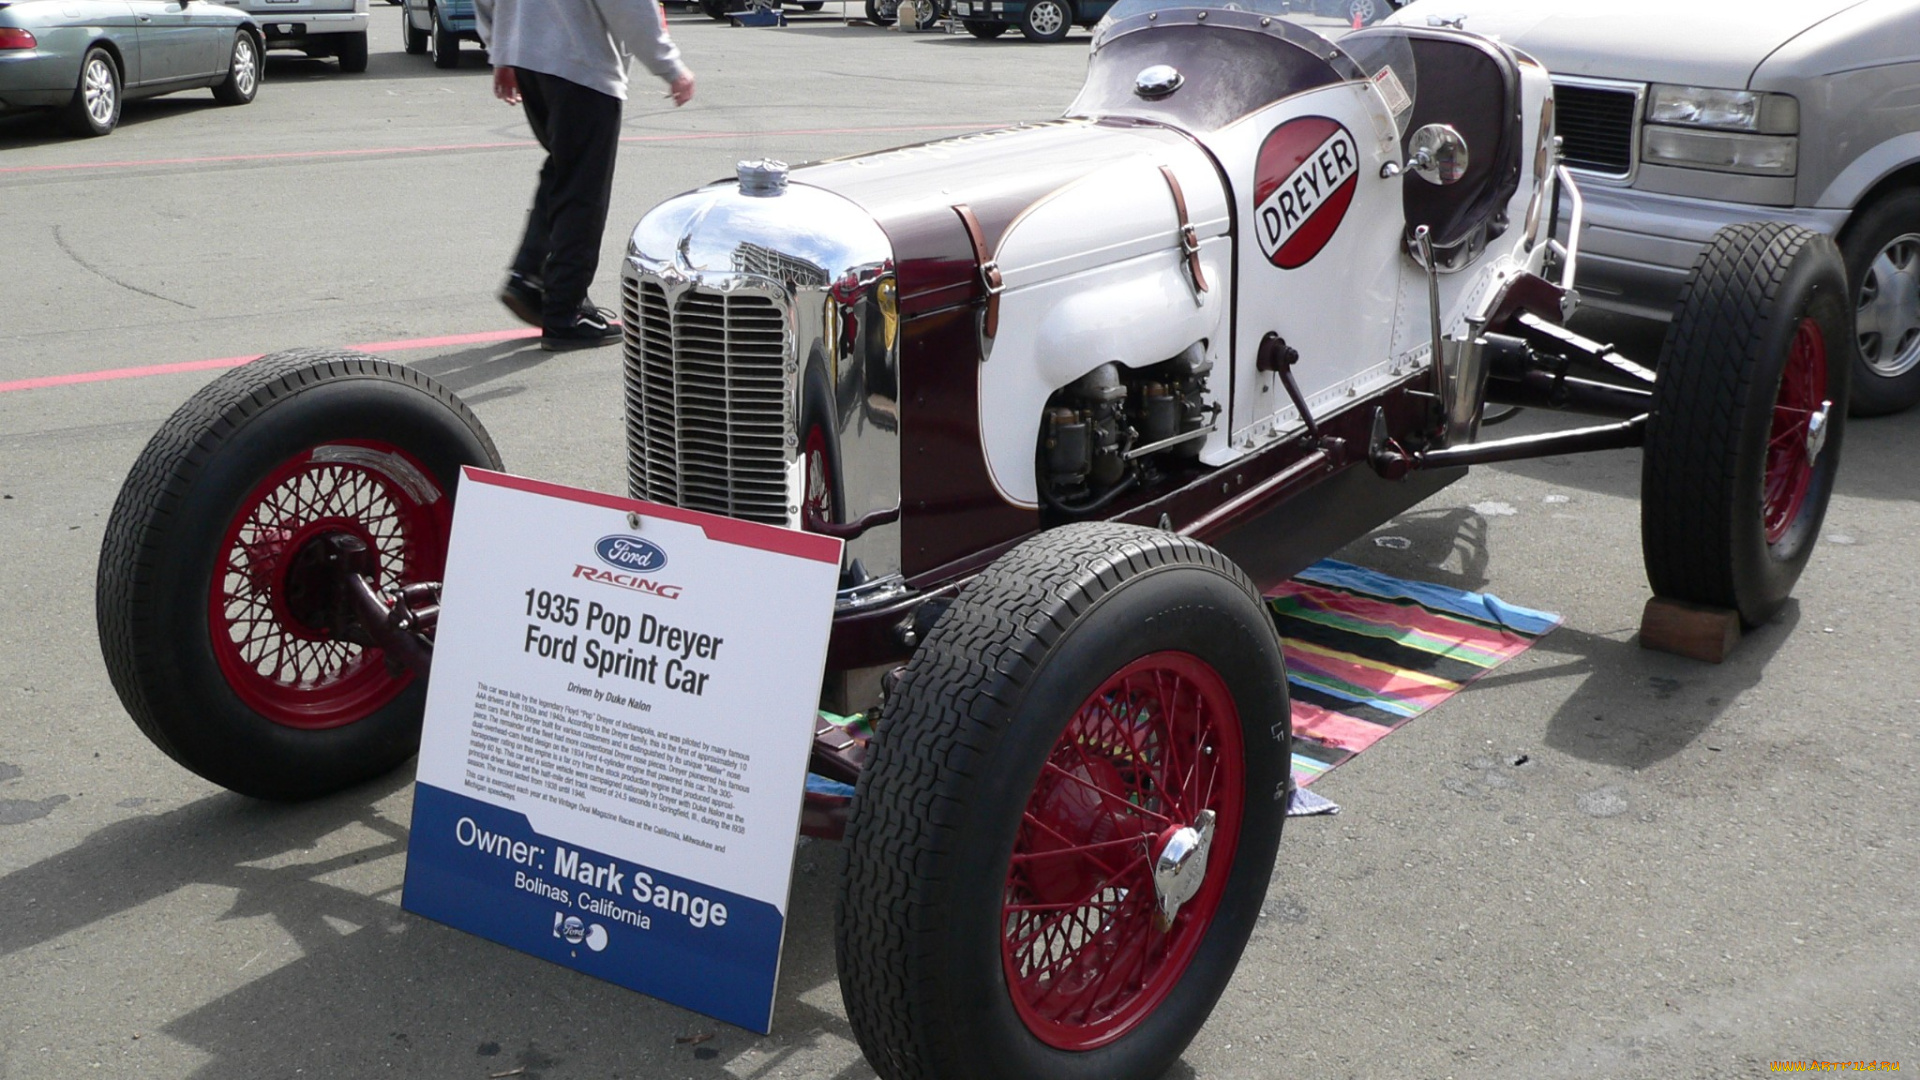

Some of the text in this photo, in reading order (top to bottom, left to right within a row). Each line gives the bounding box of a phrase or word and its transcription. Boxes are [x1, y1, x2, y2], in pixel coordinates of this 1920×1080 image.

[1262, 139, 1352, 246] DREYER
[572, 564, 682, 599] RACING
[608, 539, 653, 567] Ford
[525, 588, 723, 660] 1935 Pop Dreyer
[525, 624, 709, 696] Ford Sprint Car
[567, 682, 651, 712] Driven by Duke Nalon
[456, 817, 727, 927] Owner: Mark Sange
[515, 871, 650, 929] Bolinas, California
